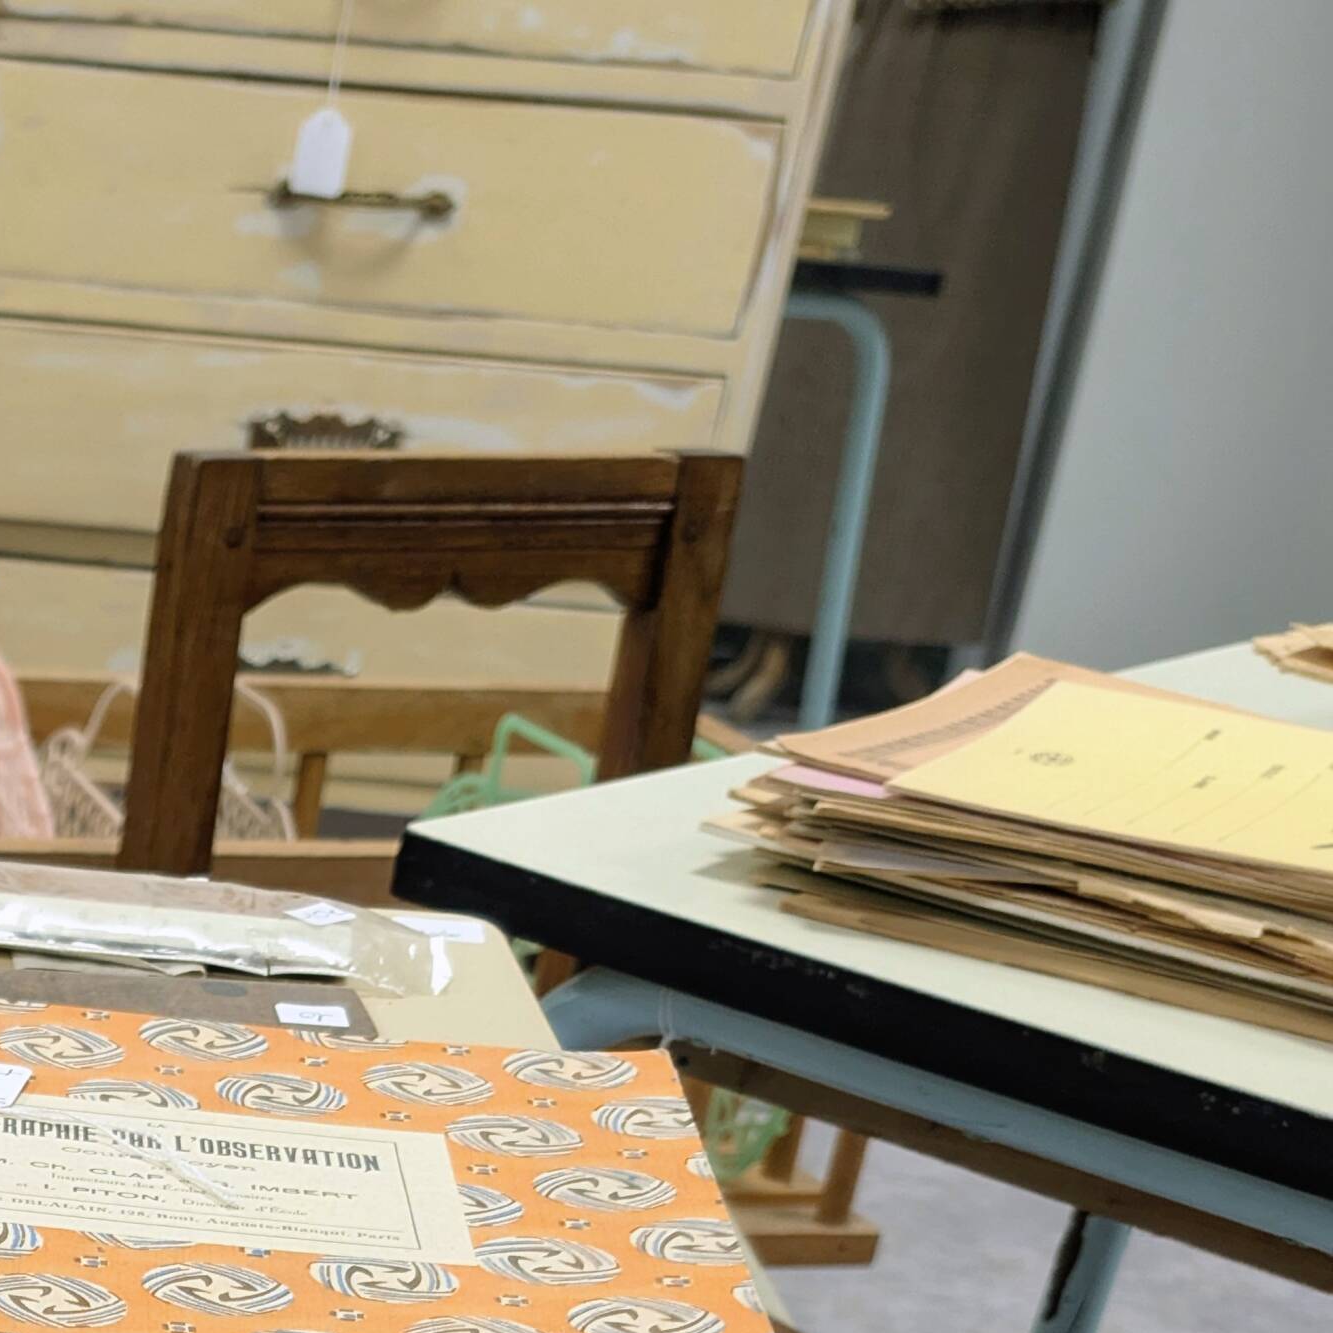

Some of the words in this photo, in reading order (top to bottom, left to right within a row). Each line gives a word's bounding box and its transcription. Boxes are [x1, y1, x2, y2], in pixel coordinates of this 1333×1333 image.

[174, 1134, 382, 1173] L'OBSERVATION
[29, 1160, 73, 1172] Ch.
[88, 1167, 166, 1181] CLAP
[249, 1183, 362, 1200] IMBERT
[72, 1185, 167, 1204] PITON,
[11, 1196, 114, 1214] DELALAIN,
[356, 1231, 402, 1242] Paris
